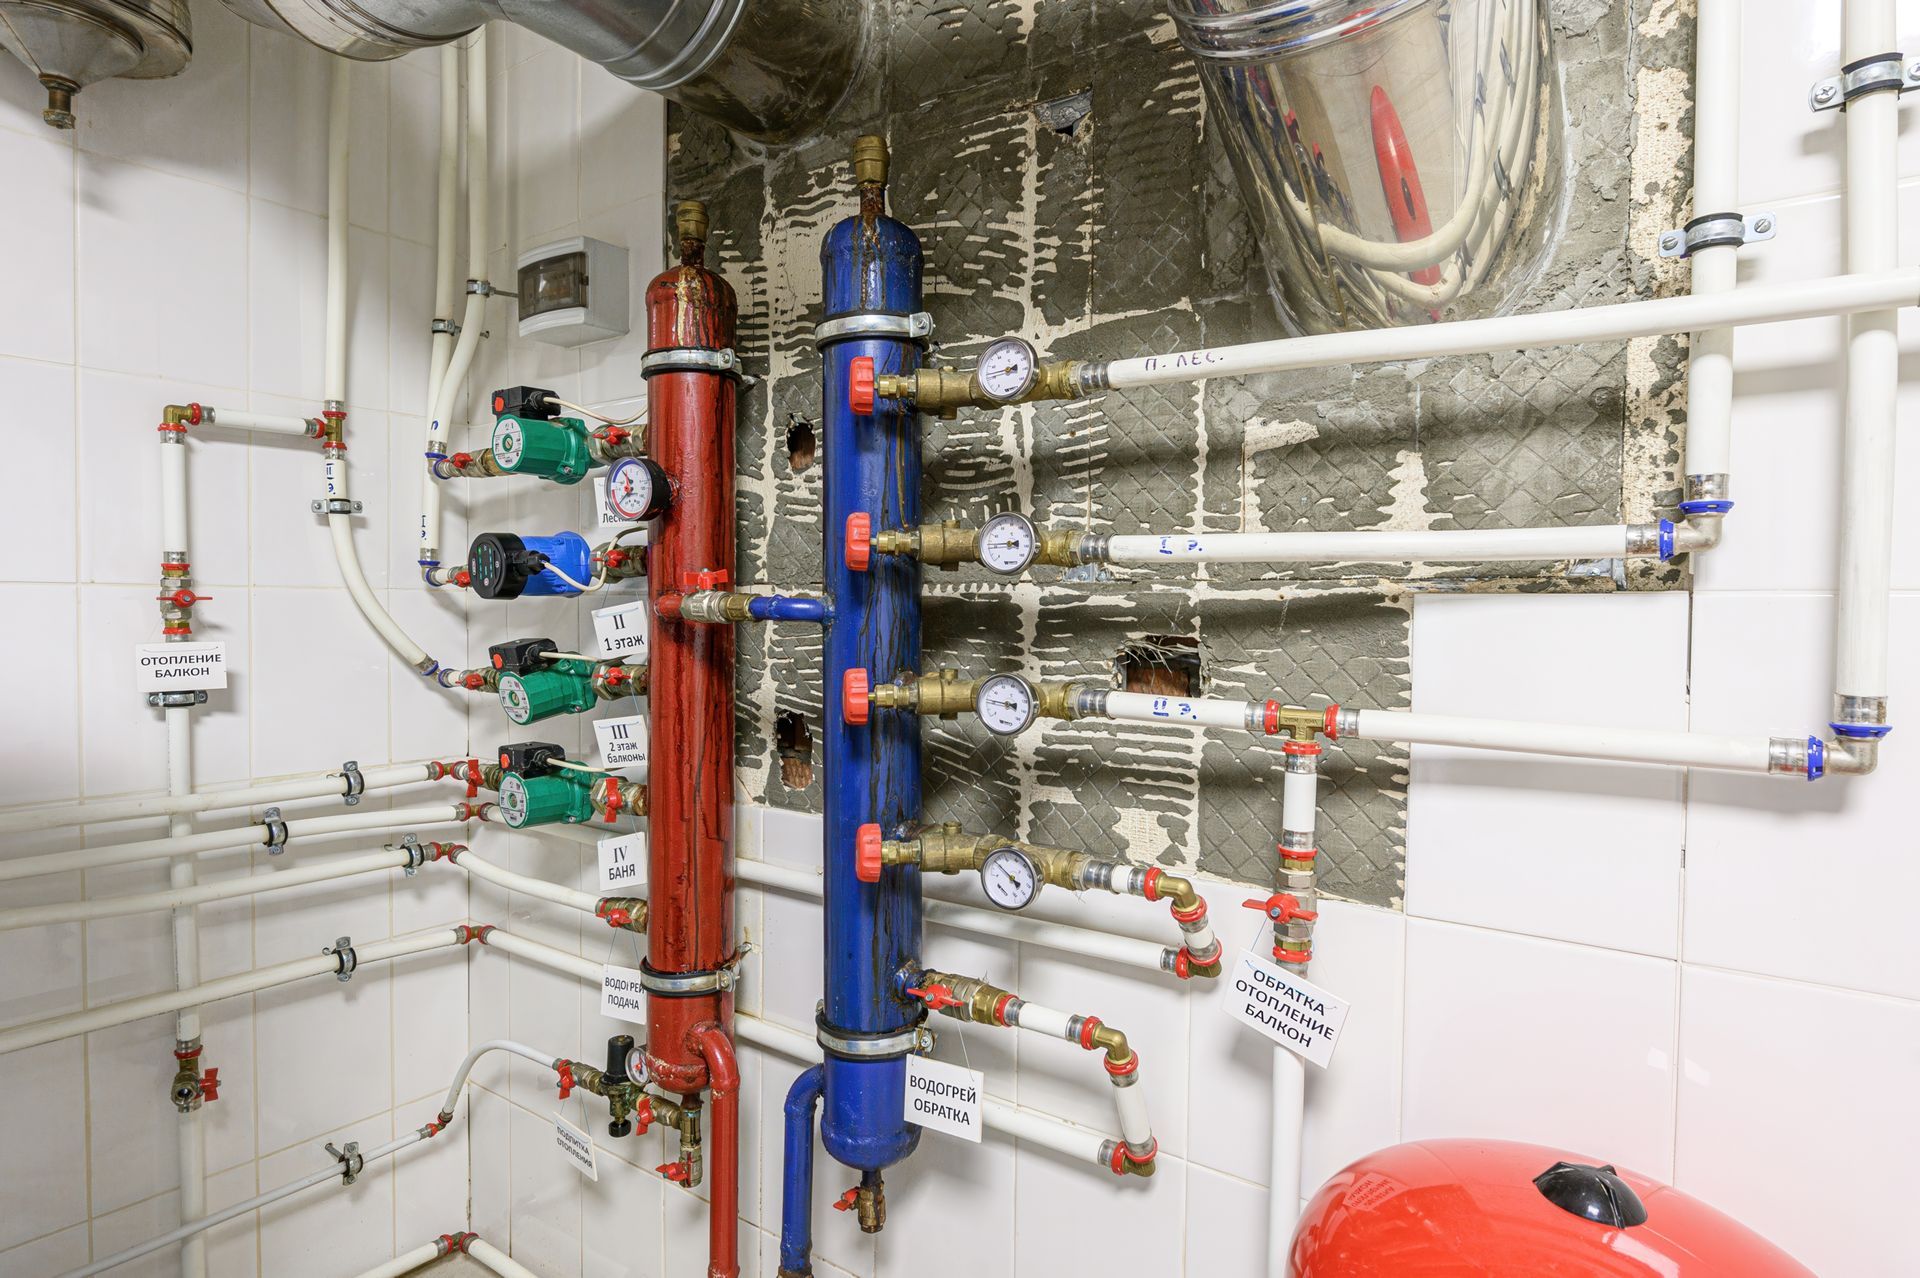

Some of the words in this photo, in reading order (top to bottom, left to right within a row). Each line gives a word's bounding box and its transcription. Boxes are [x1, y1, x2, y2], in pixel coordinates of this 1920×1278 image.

[613, 614, 625, 630] II
[604, 637, 613, 651] 1
[614, 635, 645, 650] этаж
[141, 653, 222, 667] ОТОПЛЕНИЕ
[155, 667, 210, 679] БАЛКОН
[611, 724, 629, 740] III
[609, 742, 616, 752] 2
[616, 742, 639, 752] этаж
[607, 753, 646, 764] балконы
[613, 845, 628, 864] IV
[608, 864, 636, 881] БАНЯ
[1253, 969, 1325, 1017] ОБРАТКА
[607, 994, 640, 1011] ПОДАЧА
[1235, 979, 1335, 1041] ОТОПЛЕНИЕ
[1245, 1003, 1312, 1048] БАЛКОН
[910, 1074, 976, 1105] ВОДОГРЕЙ
[914, 1098, 970, 1126] ОБРАТКА
